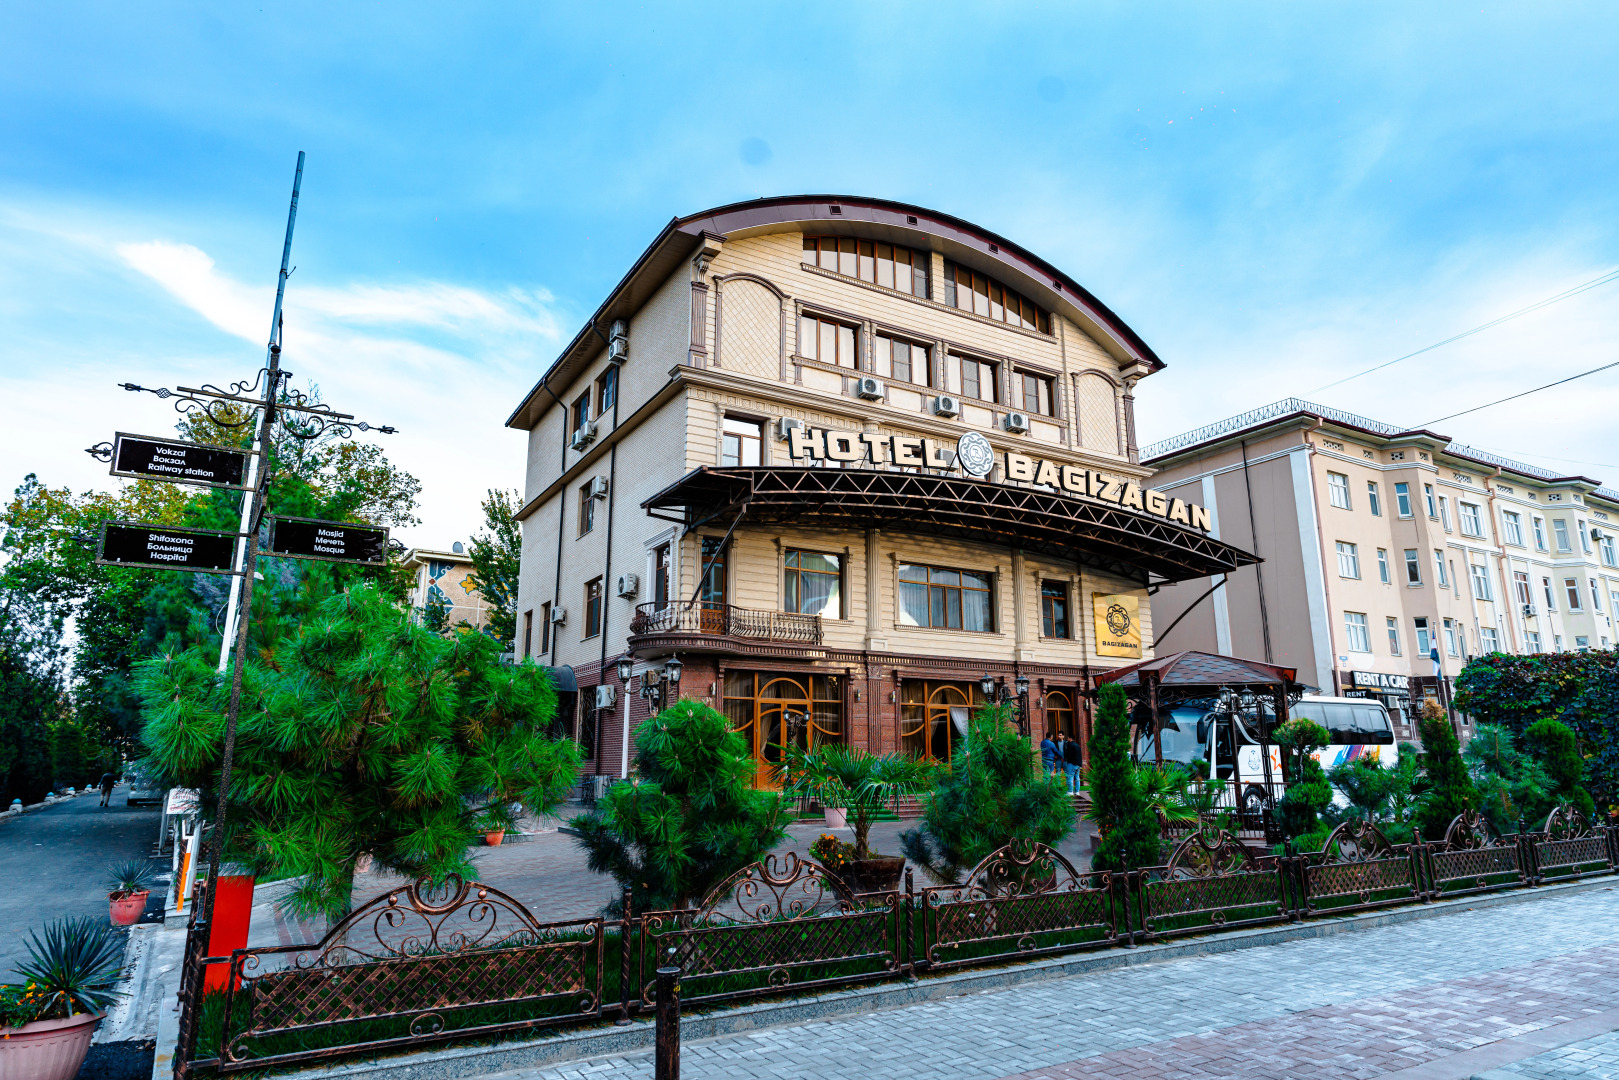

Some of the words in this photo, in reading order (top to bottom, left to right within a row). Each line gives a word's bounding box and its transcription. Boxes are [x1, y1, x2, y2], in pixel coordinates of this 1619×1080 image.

[155, 446, 186, 457] Vokzal
[153, 455, 186, 466] Вокзал
[148, 463, 182, 474] Railway
[184, 468, 214, 477] station
[787, 427, 947, 469] HOTEL
[1004, 452, 1211, 532] BAGIZAGAN
[318, 529, 344, 538] Masjid
[148, 534, 194, 545] Shifoxona
[315, 537, 345, 546] Мечеть
[147, 543, 193, 554] Больница
[314, 545, 346, 555] Mosque
[150, 552, 188, 562] Hospital
[1354, 672, 1379, 685] RENT
[1380, 674, 1390, 687] A
[1388, 676, 1409, 688] CAR
